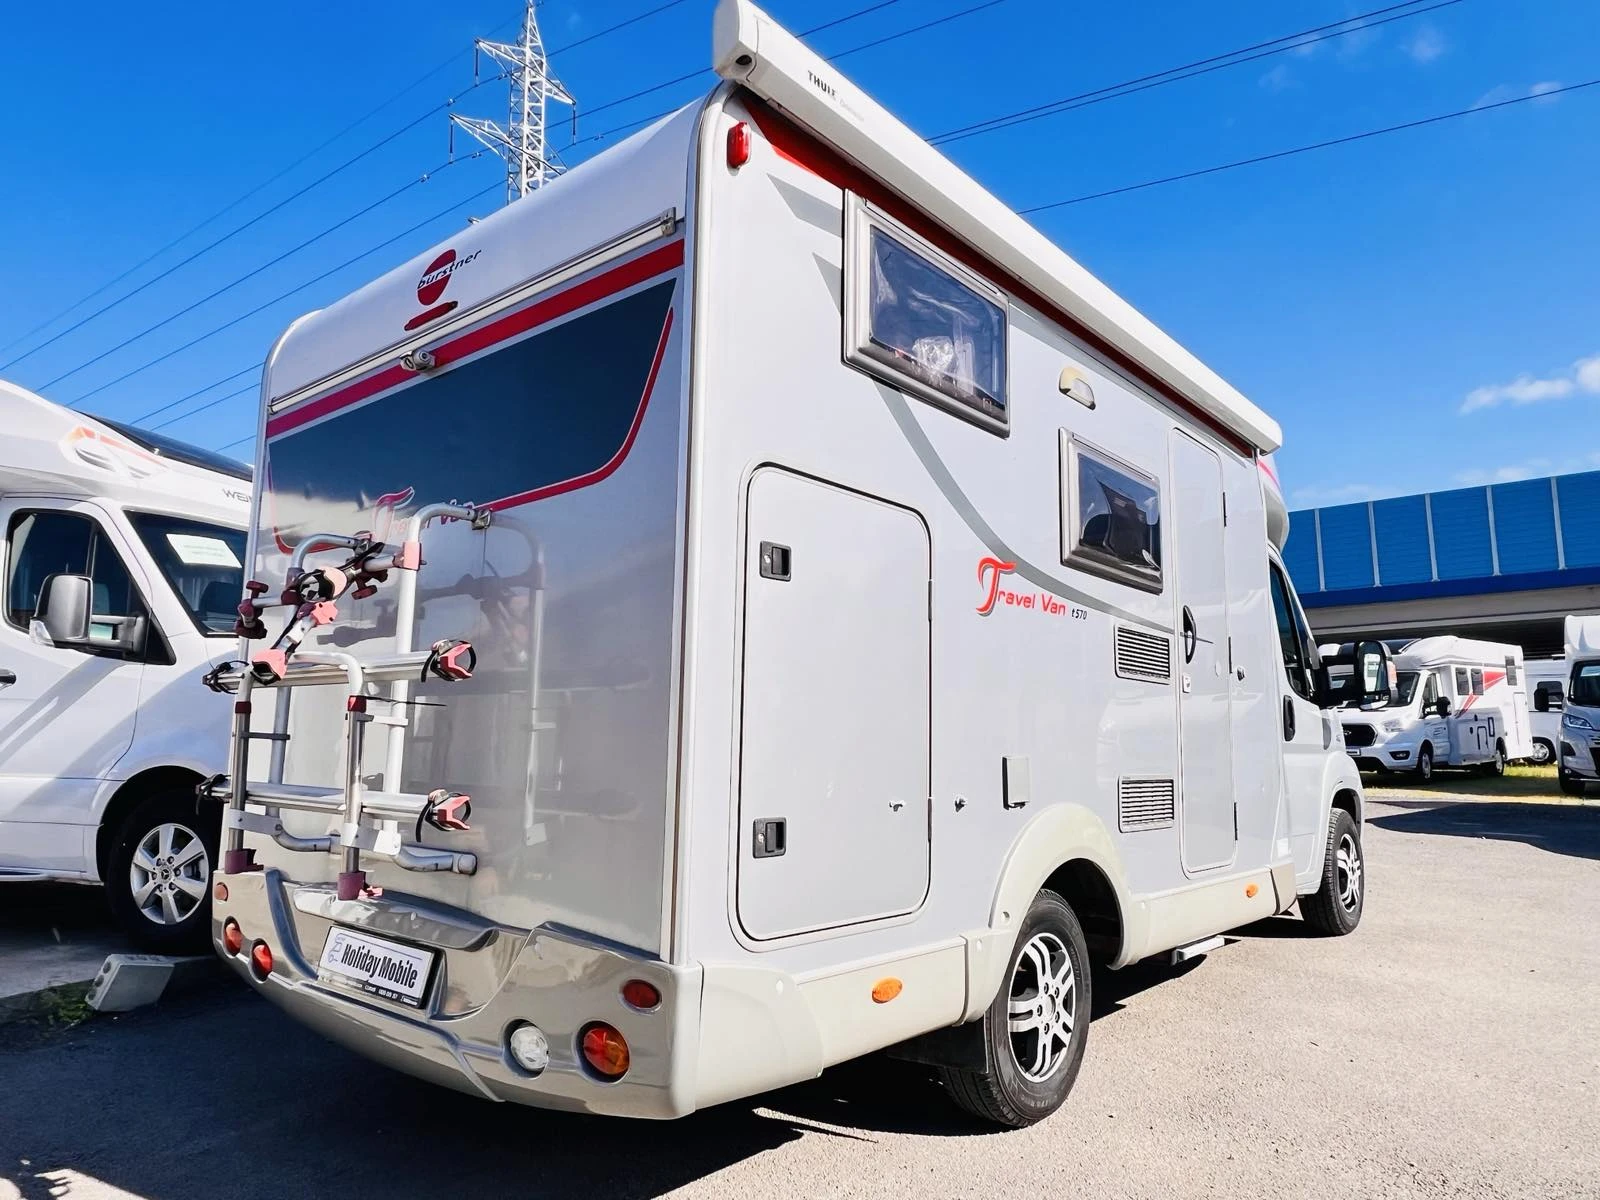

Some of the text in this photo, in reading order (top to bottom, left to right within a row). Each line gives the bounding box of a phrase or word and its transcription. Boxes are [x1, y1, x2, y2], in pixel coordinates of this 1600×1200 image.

[417, 249, 482, 290] bürstner
[975, 556, 1088, 620] Travel Van t570
[340, 943, 418, 989] Holiday Mobile
